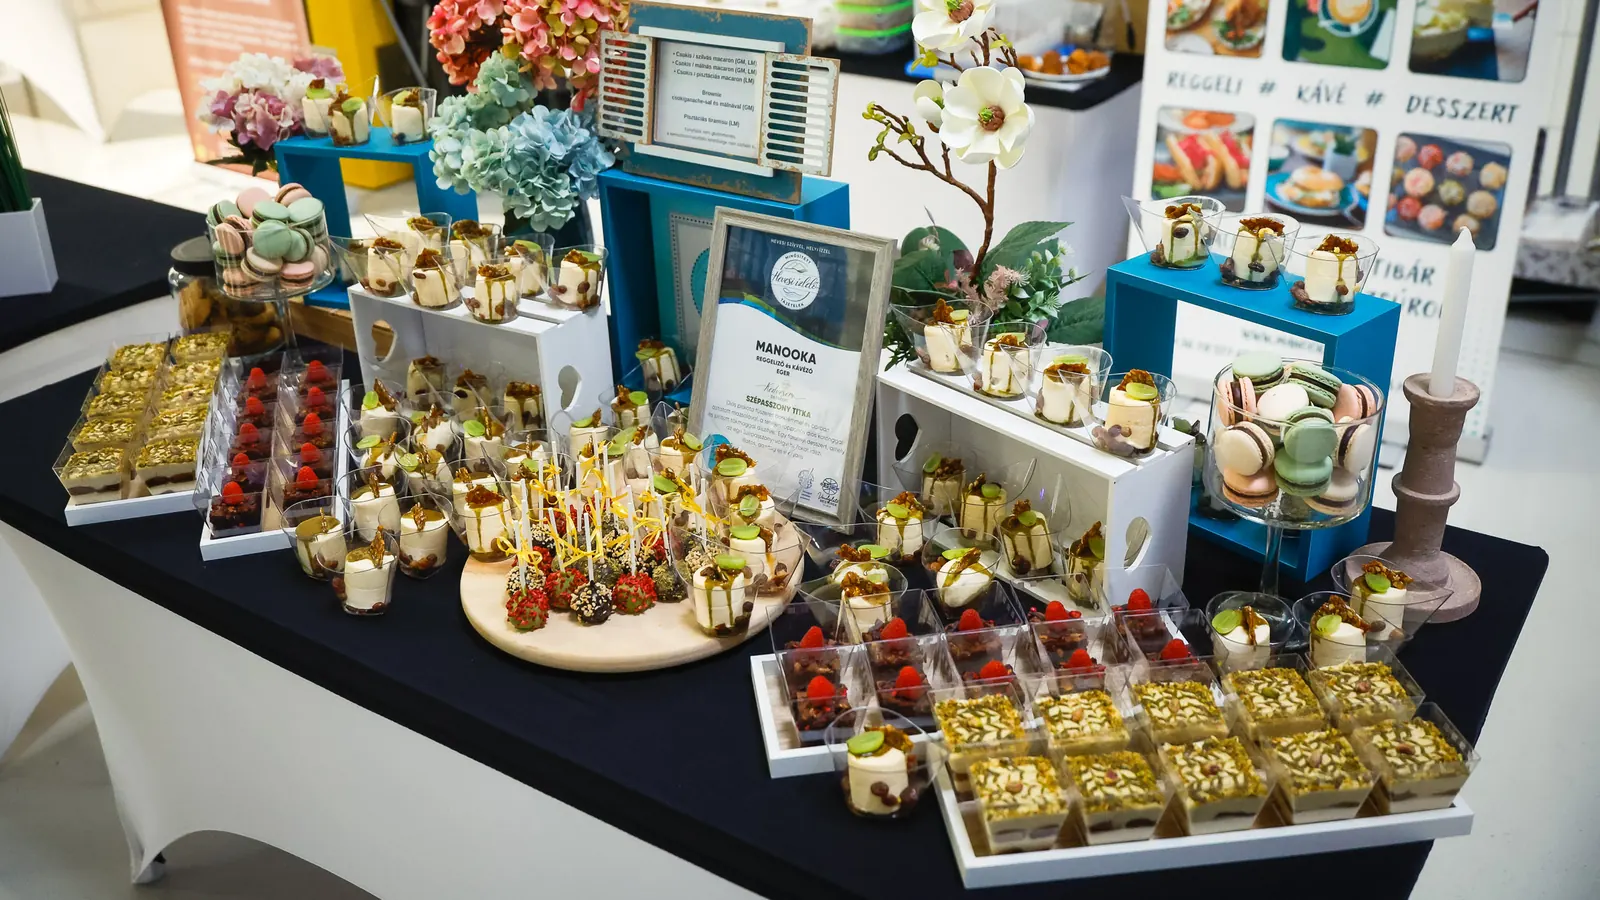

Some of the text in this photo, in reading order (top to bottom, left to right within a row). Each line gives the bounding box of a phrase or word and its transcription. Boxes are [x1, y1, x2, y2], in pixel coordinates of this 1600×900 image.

[743, 77, 755, 85] (LM)
[702, 89, 722, 97] Brownie
[1166, 71, 1243, 95] REGGELI
[1297, 79, 1346, 106] KÁVÉ
[1405, 94, 1521, 124] DESSZERT
[742, 104, 754, 112] (GM)
[756, 340, 816, 365] MANOOKA
[756, 355, 784, 367] REGGELIZŐ
[792, 363, 813, 374] KÁVÉZÓ
[746, 395, 791, 412] SZÉPASSZONY
[792, 407, 811, 418] TITKA
